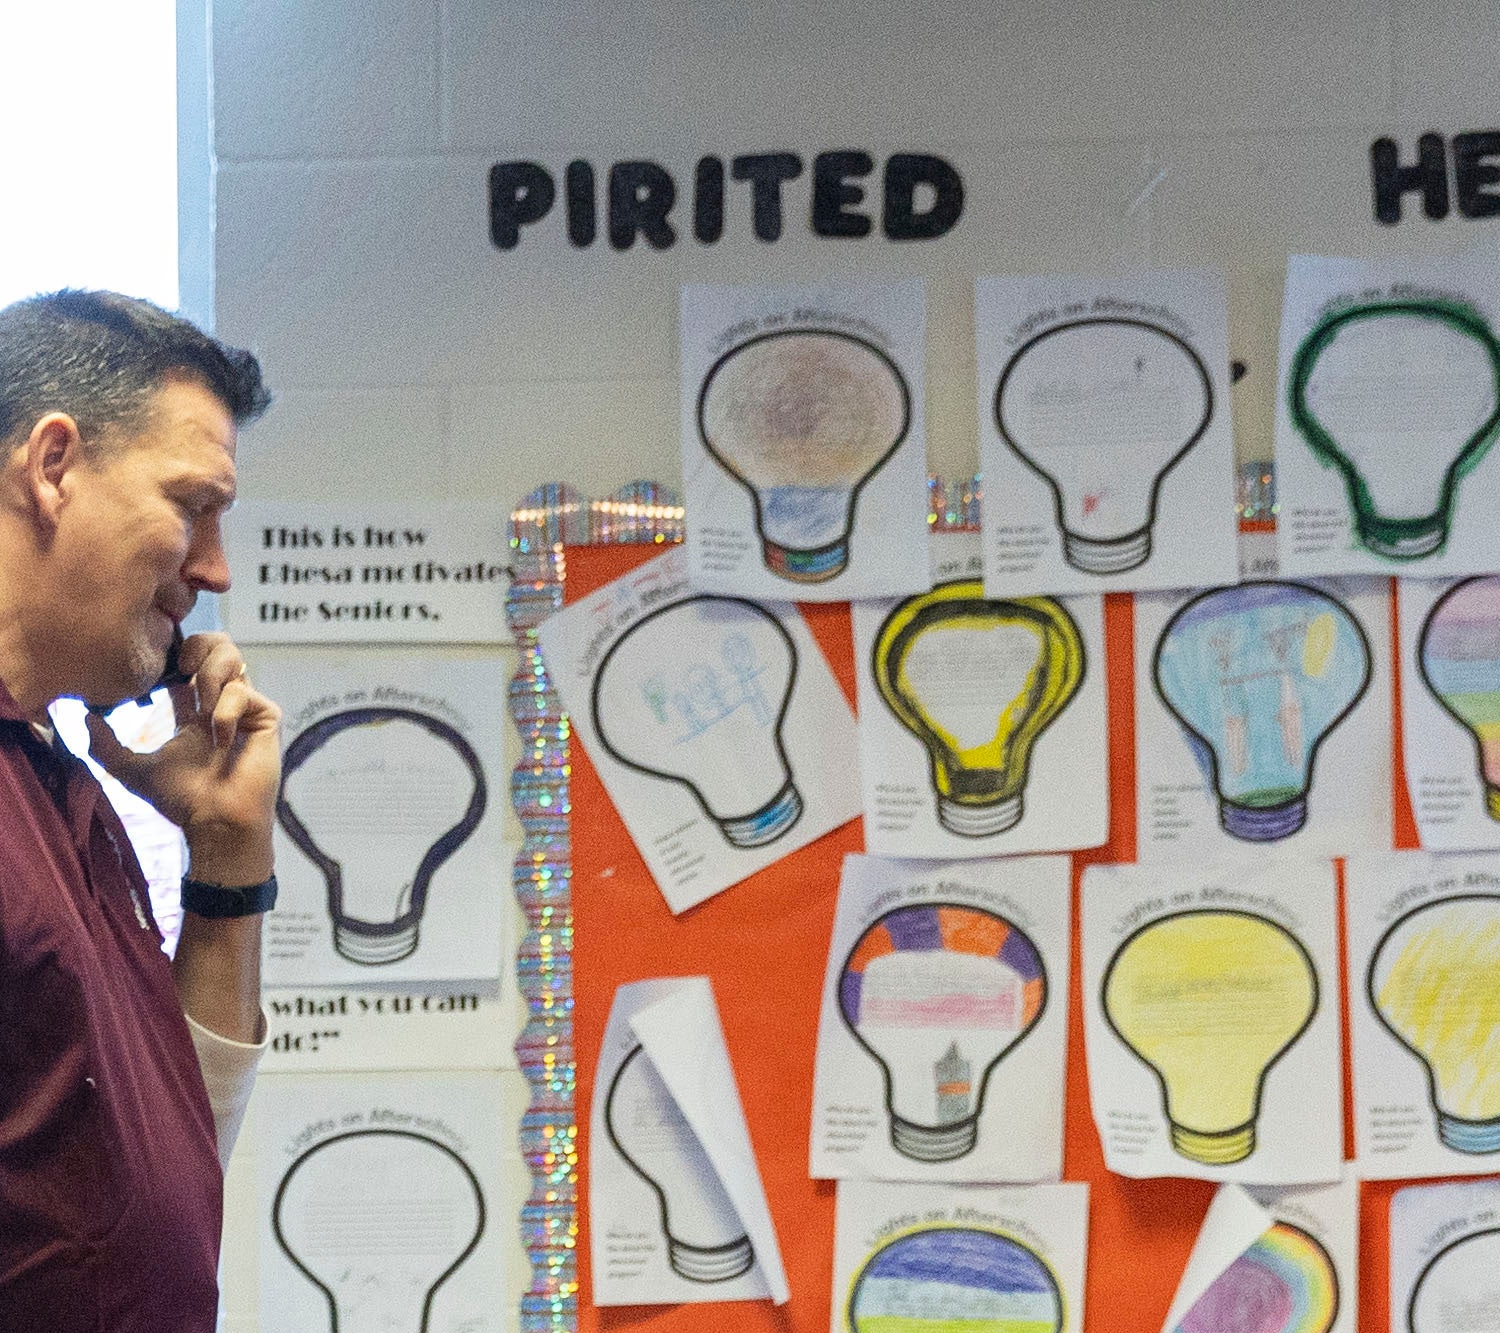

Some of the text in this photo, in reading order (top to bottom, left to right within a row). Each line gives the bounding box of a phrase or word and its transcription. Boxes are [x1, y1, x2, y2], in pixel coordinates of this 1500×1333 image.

[487, 150, 966, 250] PIRITED
[262, 525, 428, 548] This is how
[259, 602, 309, 622] the
[271, 995, 348, 1016] what
